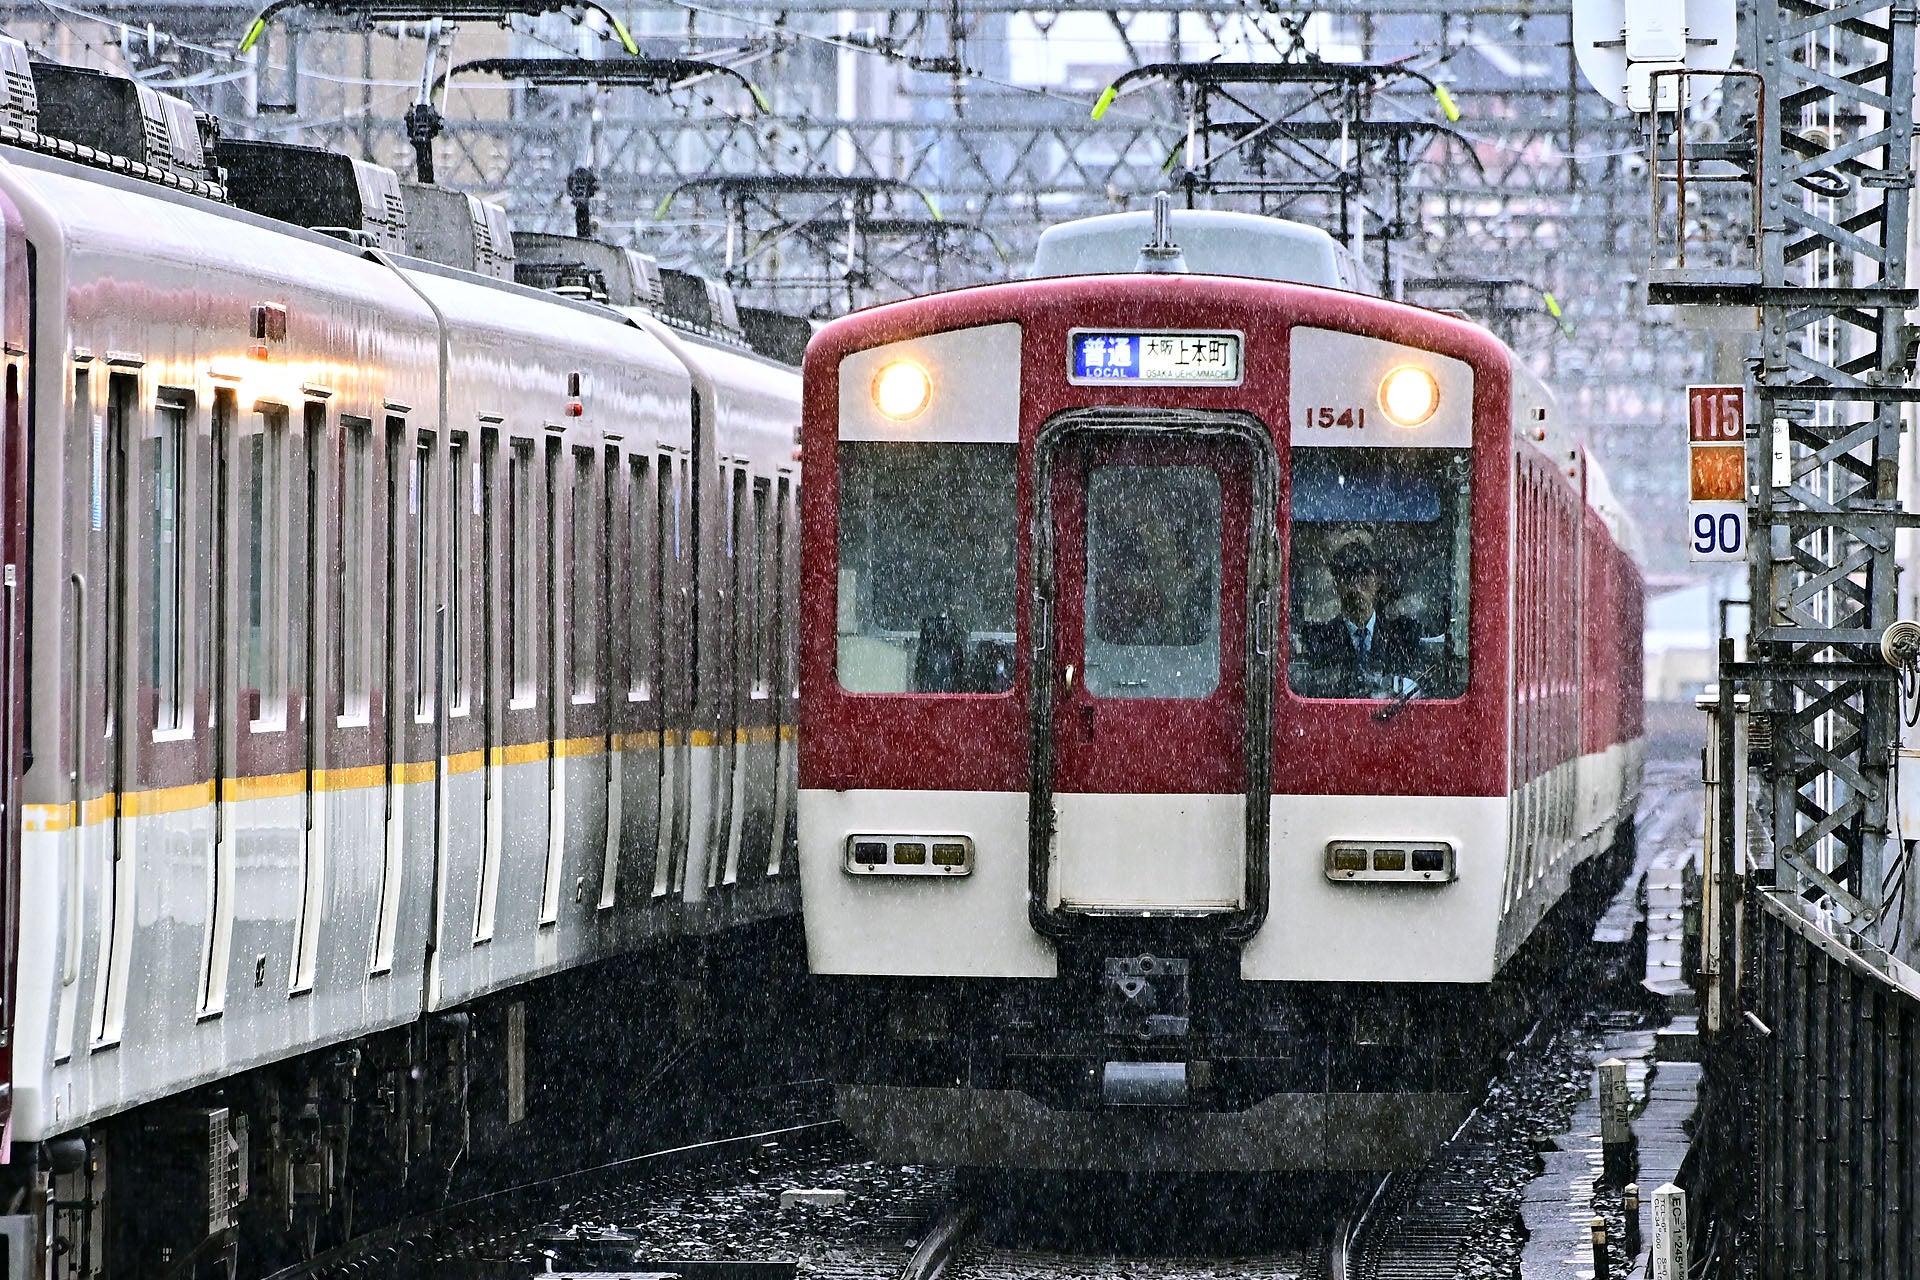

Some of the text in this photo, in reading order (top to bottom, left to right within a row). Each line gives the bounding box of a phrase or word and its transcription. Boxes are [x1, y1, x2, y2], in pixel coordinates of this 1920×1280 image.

[1082, 338, 1132, 367] 普通
[1086, 368, 1127, 378] LOCAL
[1146, 370, 1173, 378] OSAKA
[1307, 408, 1364, 428] 1541
[1692, 394, 1740, 437] 115
[1694, 513, 1741, 554] 90
